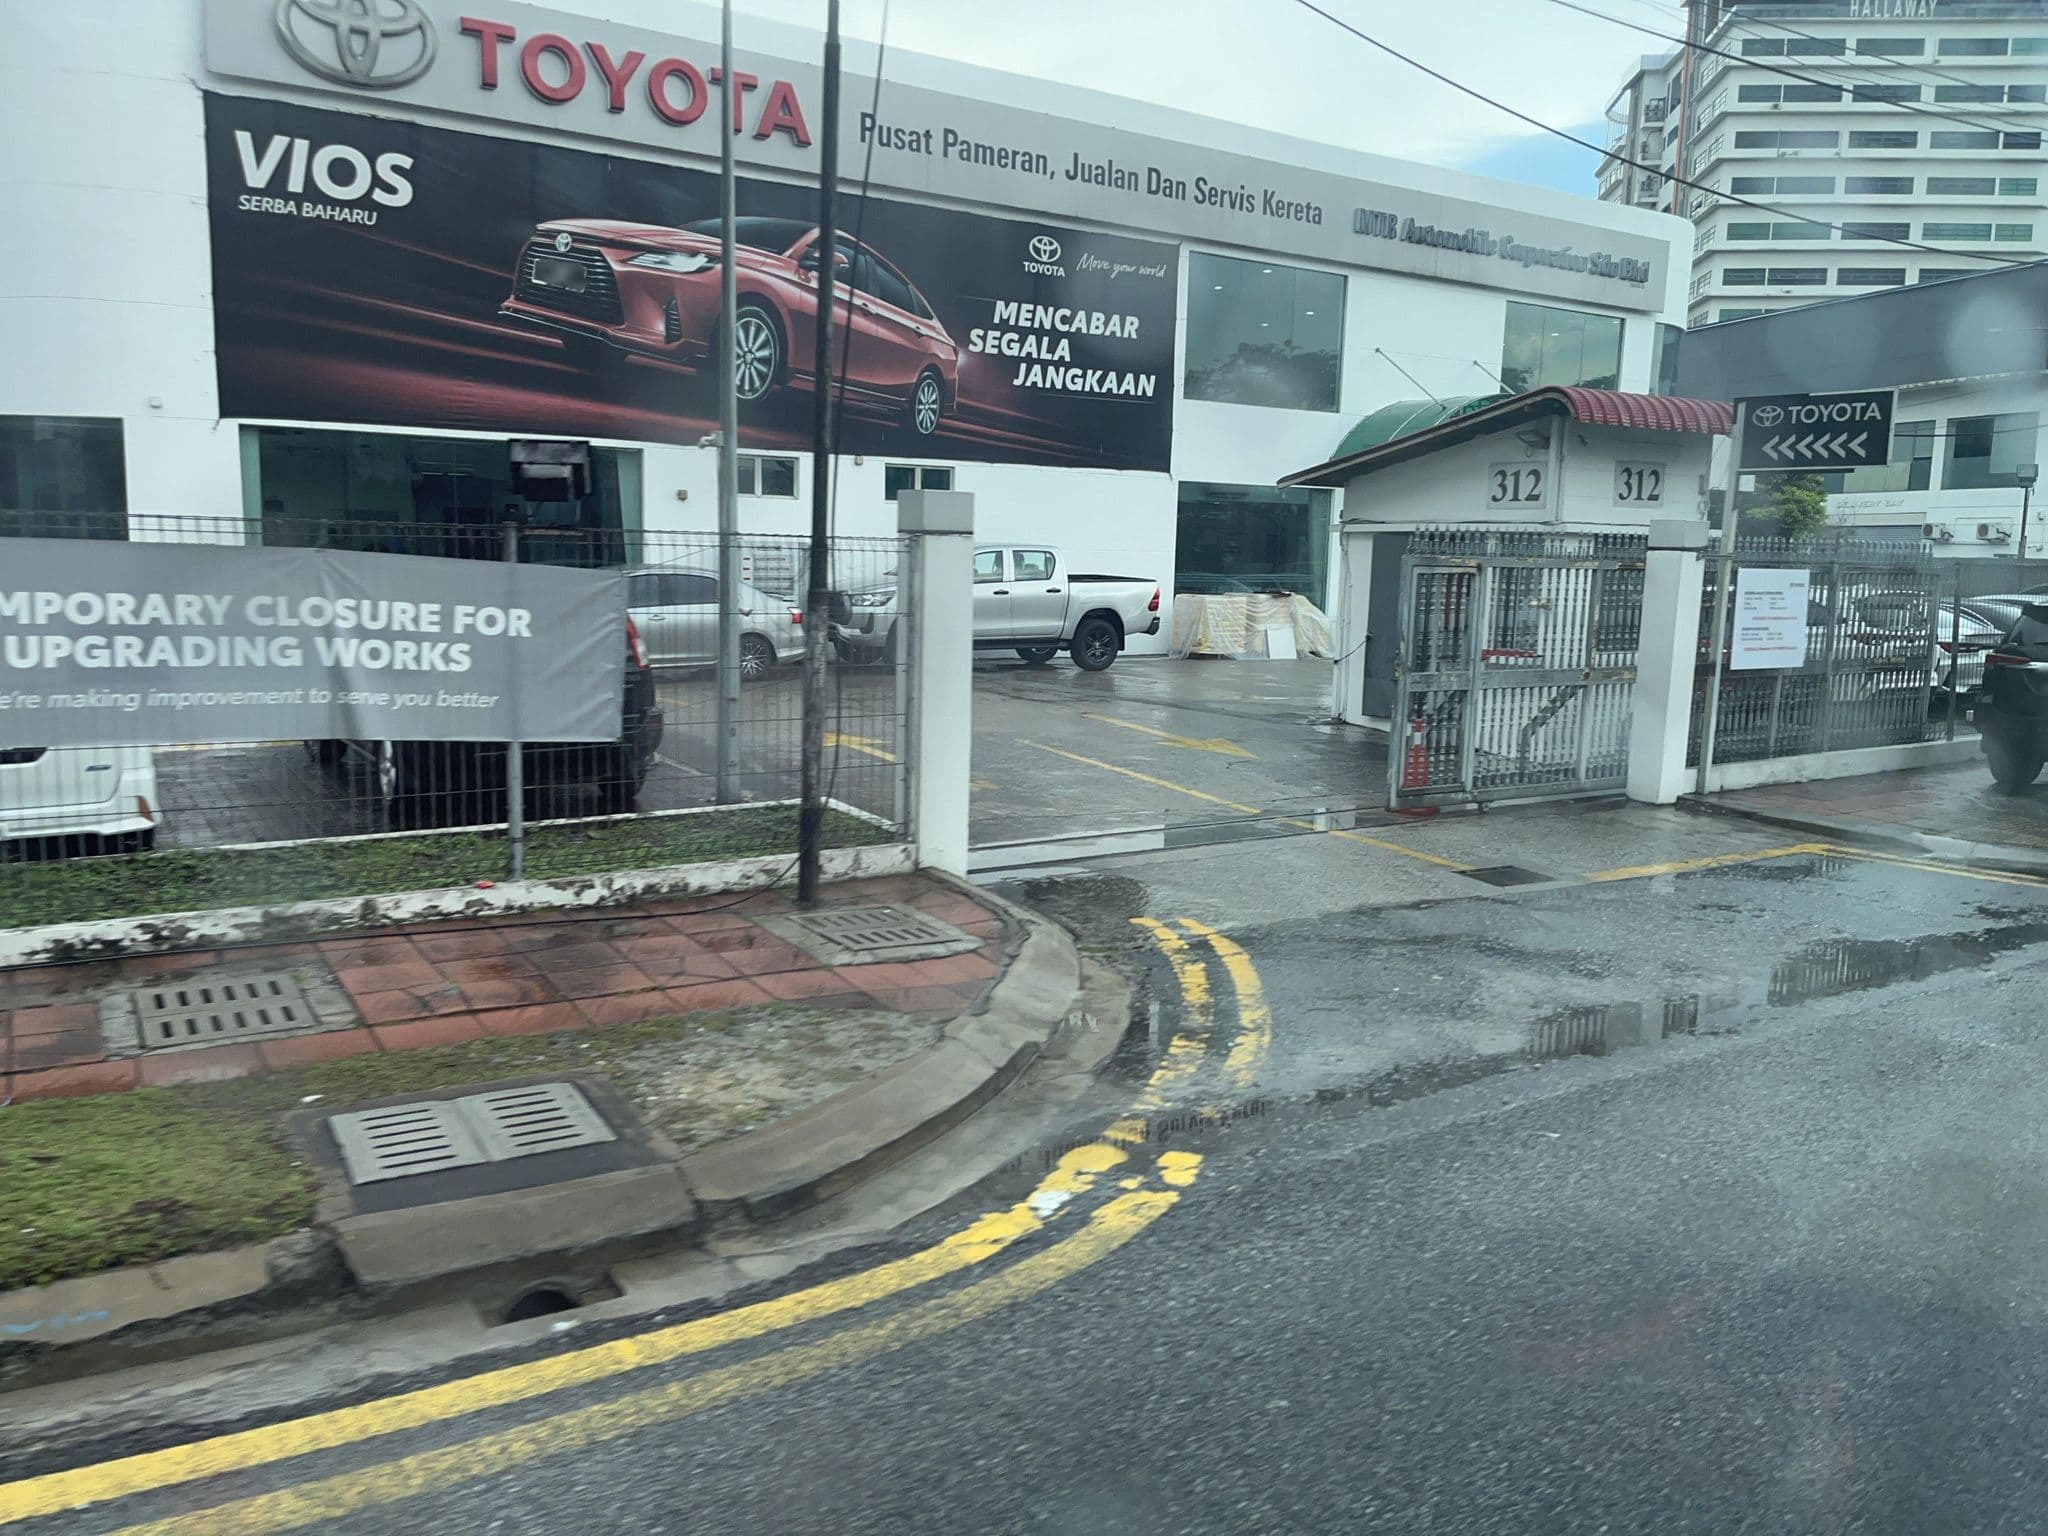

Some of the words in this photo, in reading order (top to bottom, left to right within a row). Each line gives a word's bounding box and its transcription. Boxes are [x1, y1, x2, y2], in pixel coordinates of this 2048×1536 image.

[1850, 0, 1938, 18] HALLAWAY
[460, 16, 813, 148] TOYOTA
[234, 129, 415, 208] VIOS
[859, 111, 933, 156] Pusat
[942, 127, 1056, 181] Pameran,
[1065, 152, 1140, 192] Jualan
[1146, 166, 1187, 202] Dan
[1194, 177, 1256, 214] Servis
[1262, 189, 1323, 226] Kereta
[238, 194, 298, 216] SERBA
[301, 201, 378, 226] BAHARU
[1023, 261, 1066, 278] TOYOTA
[1076, 252, 1110, 272] Move
[1110, 263, 1137, 279] your
[1138, 264, 1167, 279] world
[993, 299, 1140, 340] MENCABAR
[967, 328, 1071, 362] SEGALA
[1012, 362, 1157, 398] JANGKAAN
[1788, 402, 1882, 425] TOYOTA
[1490, 467, 1543, 504] 312
[1617, 466, 1661, 502] 312
[244, 595, 442, 633] CLOSURE
[452, 604, 533, 638] FOR
[4, 634, 304, 669] UPGRADING
[313, 636, 473, 673] WORKS
[47, 688, 142, 712] making
[146, 687, 305, 711] improvement
[308, 688, 332, 704] to
[336, 691, 390, 706] serve
[391, 692, 431, 710] you
[436, 690, 500, 708] better
